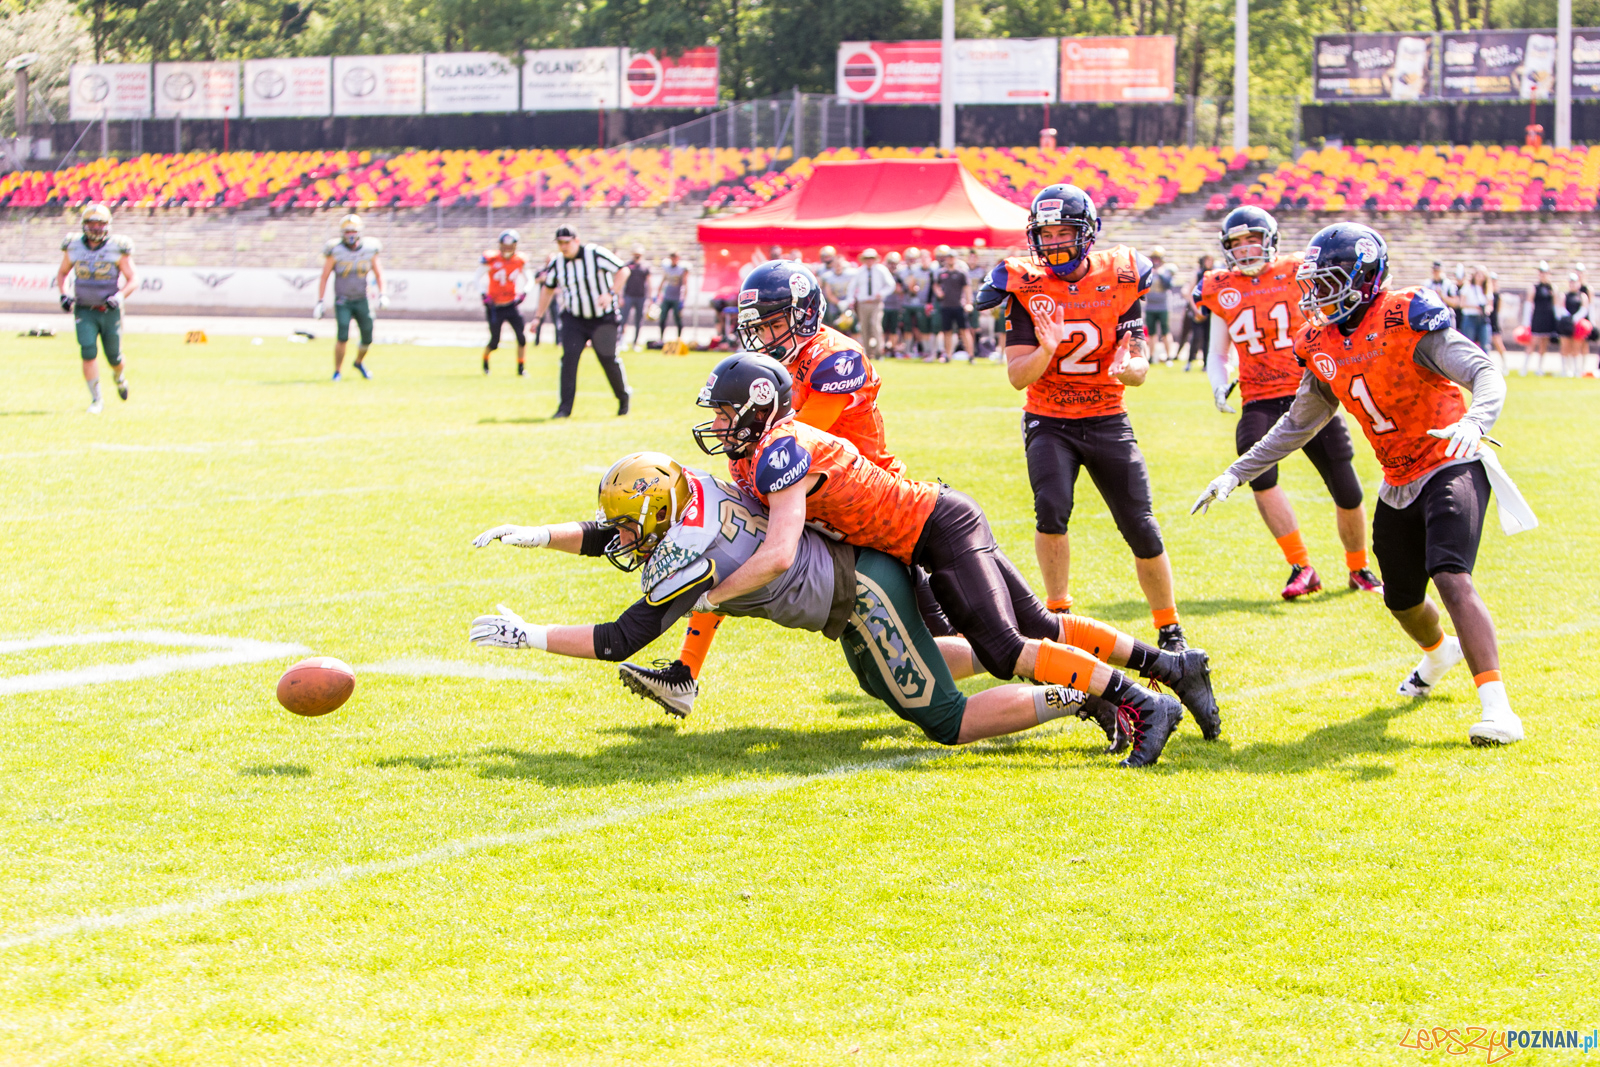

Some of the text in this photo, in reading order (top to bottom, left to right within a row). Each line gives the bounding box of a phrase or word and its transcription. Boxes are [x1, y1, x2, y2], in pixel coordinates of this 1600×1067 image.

[1058, 299, 1112, 309] WENGLORZ
[1229, 301, 1294, 355] 41
[1058, 319, 1102, 375] 2
[1337, 348, 1385, 367] WENGLORZ
[821, 373, 866, 392] BOGWAY
[1054, 394, 1104, 404] CASHBACK
[1060, 388, 1100, 397] OLSZTYN
[1349, 374, 1398, 435] 1
[769, 453, 809, 492] BOGWAY
